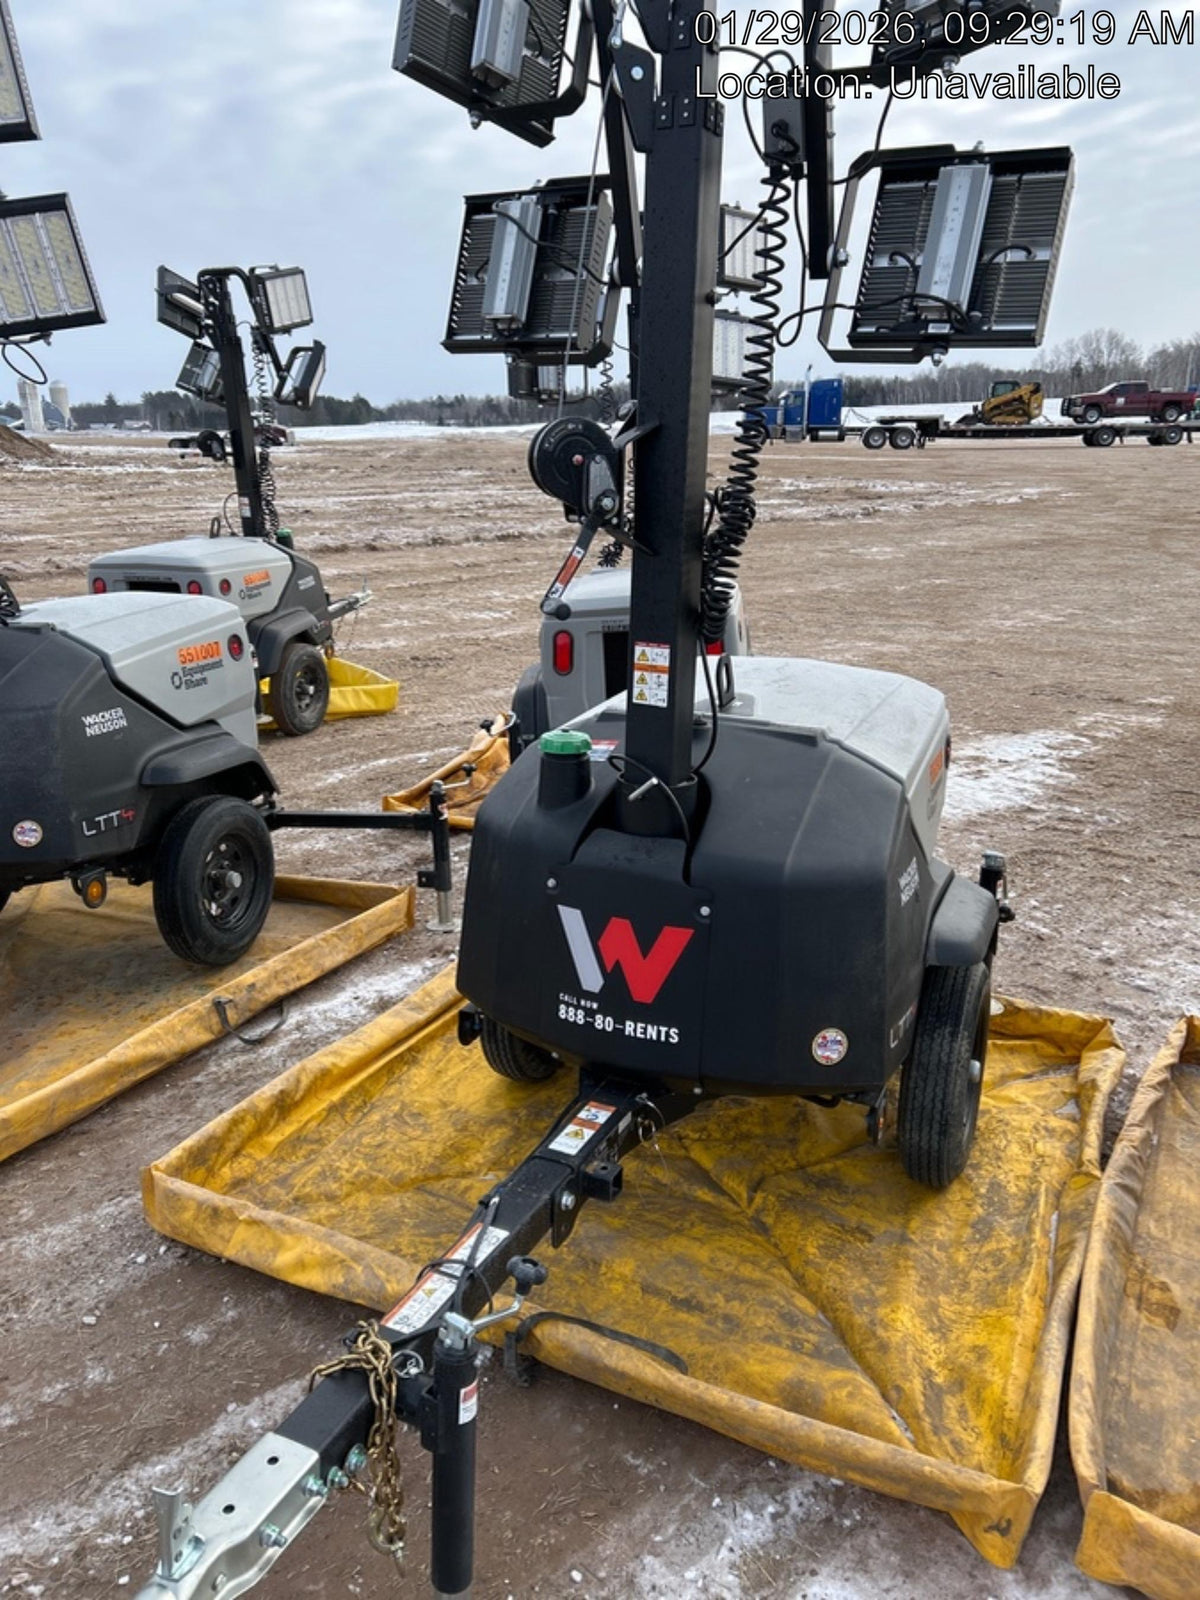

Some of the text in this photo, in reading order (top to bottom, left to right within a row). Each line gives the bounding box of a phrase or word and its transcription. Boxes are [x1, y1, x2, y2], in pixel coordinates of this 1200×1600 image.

[181, 659, 224, 677] Equipment
[184, 676, 208, 690] Share
[81, 707, 124, 726] WACKER
[85, 718, 128, 737] NEUSON
[82, 808, 136, 837] LTT4
[558, 1003, 680, 1044] 888-80-RENTS
